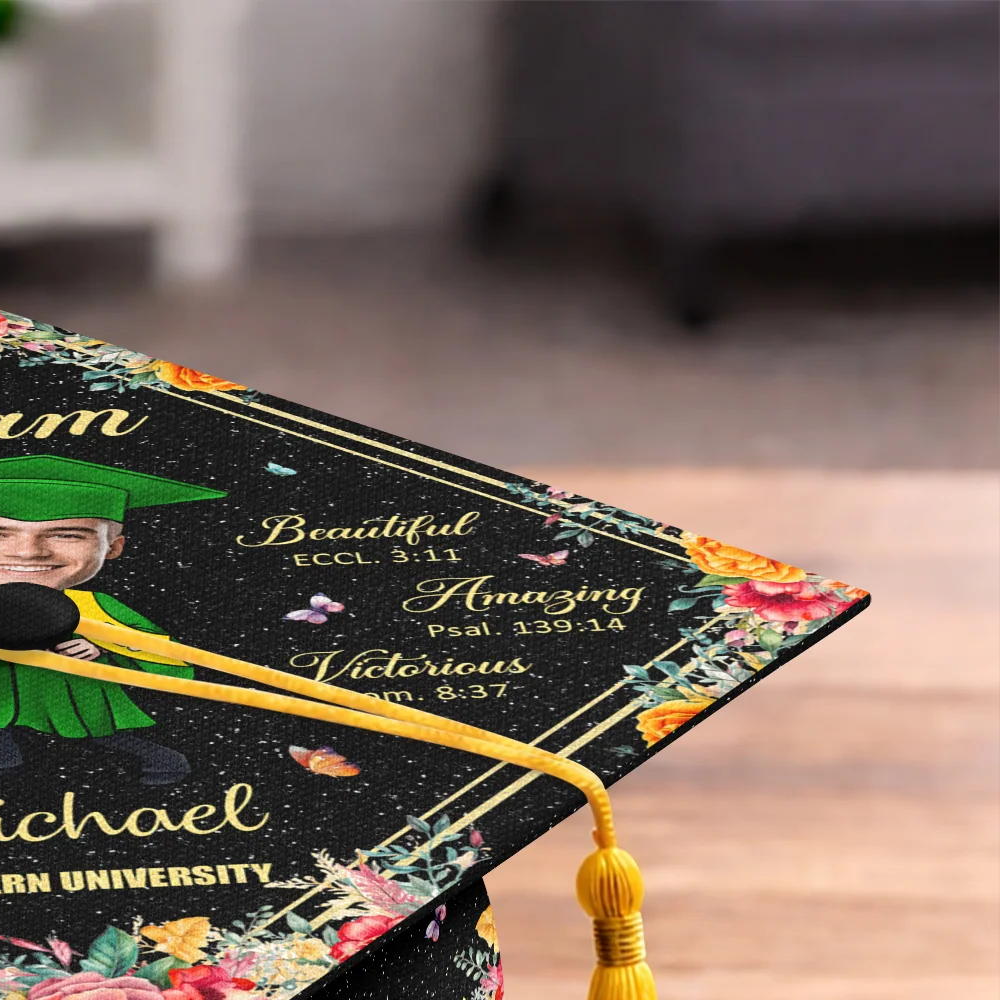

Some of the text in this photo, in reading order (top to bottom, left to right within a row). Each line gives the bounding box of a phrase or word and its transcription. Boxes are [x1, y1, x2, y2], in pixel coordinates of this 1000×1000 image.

[236, 511, 480, 547] Beautiful
[294, 548, 462, 567] ECCL. 3:11
[402, 575, 646, 615] Amazing
[428, 618, 626, 638] Psal. 139:14
[289, 649, 533, 683] Victorious
[436, 683, 507, 700] 8:37
[60, 863, 272, 892] UNIVERSITY
